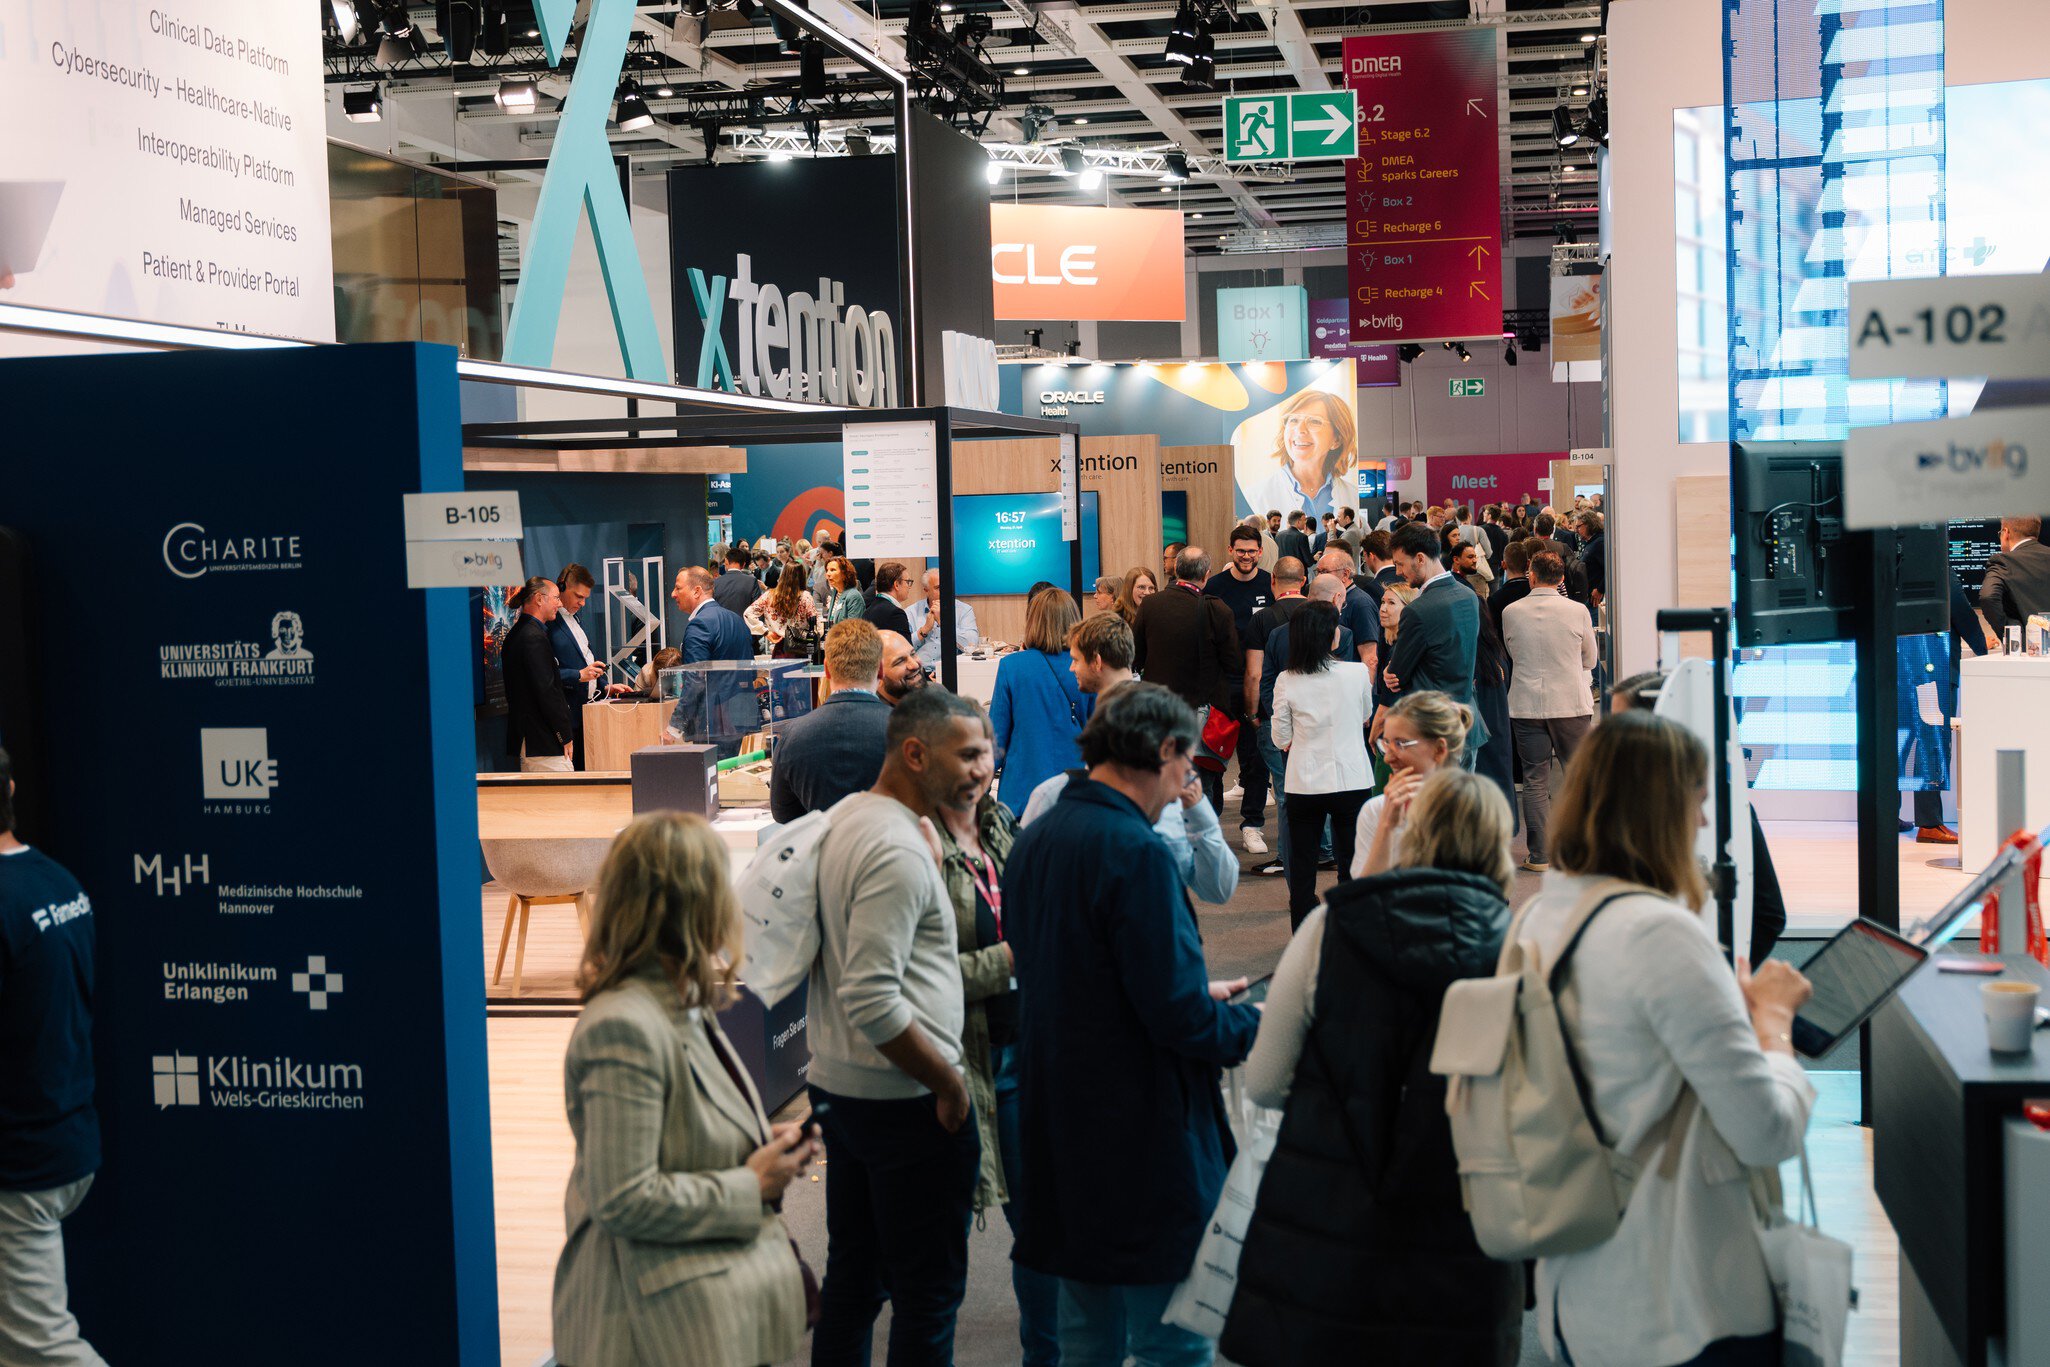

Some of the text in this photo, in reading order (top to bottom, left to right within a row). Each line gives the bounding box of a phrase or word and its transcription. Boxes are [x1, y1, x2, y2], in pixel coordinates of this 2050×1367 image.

[150, 9, 289, 76] Clinical Data Platform
[1351, 56, 1402, 73] DMEA
[52, 41, 160, 99] Cybersecurity
[177, 77, 292, 132] Healthcare-Native
[1357, 104, 1385, 122] 6.2
[1381, 128, 1430, 142] Stage 6.2
[138, 127, 295, 187] Interoperability Platform
[1382, 155, 1415, 166] DMEA
[1382, 169, 1459, 183] sparks Careers
[1383, 196, 1413, 207] Box 2
[180, 197, 297, 242] Managed Services
[1383, 220, 1441, 234] Recharge 6
[1384, 254, 1413, 265] Box 1
[143, 251, 300, 298] Patient & Provider Portal
[1385, 286, 1443, 299] Recharge 4
[1233, 302, 1285, 321] Box 1
[1372, 313, 1403, 331] bvitg
[1857, 304, 2007, 348] A-102
[687, 253, 898, 409] xtention
[1368, 354, 1388, 362] Health
[1040, 391, 1104, 404] ORACLE
[1041, 406, 1069, 416] Health
[1050, 454, 1138, 473] xention
[1572, 453, 1594, 461] B-104
[1452, 474, 1498, 489] Meet
[445, 506, 500, 525] B-105
[995, 511, 1026, 523] 16:57
[988, 539, 1036, 549] xtention
[209, 562, 302, 572] UNIVERSITÄTSMEDIZIN BERLIN
[160, 641, 261, 661] UNIVERSITÄTS
[161, 659, 314, 678] KLINIKUM FRANKFURT
[215, 675, 315, 687] GOETHE-UNIVERSITÄT
[204, 804, 271, 815] HAMBURG
[218, 884, 363, 898] Medizinische Hochschule
[218, 902, 275, 915] Hannover
[163, 962, 277, 981] Uniklinikum
[164, 982, 249, 1004] Erlangen
[773, 1028, 789, 1050] Fragen
[789, 1021, 797, 1038] Sie
[797, 1016, 805, 1031] uns
[208, 1056, 363, 1089] Klinikum
[211, 1090, 364, 1109] Wels-Grieskirchen
